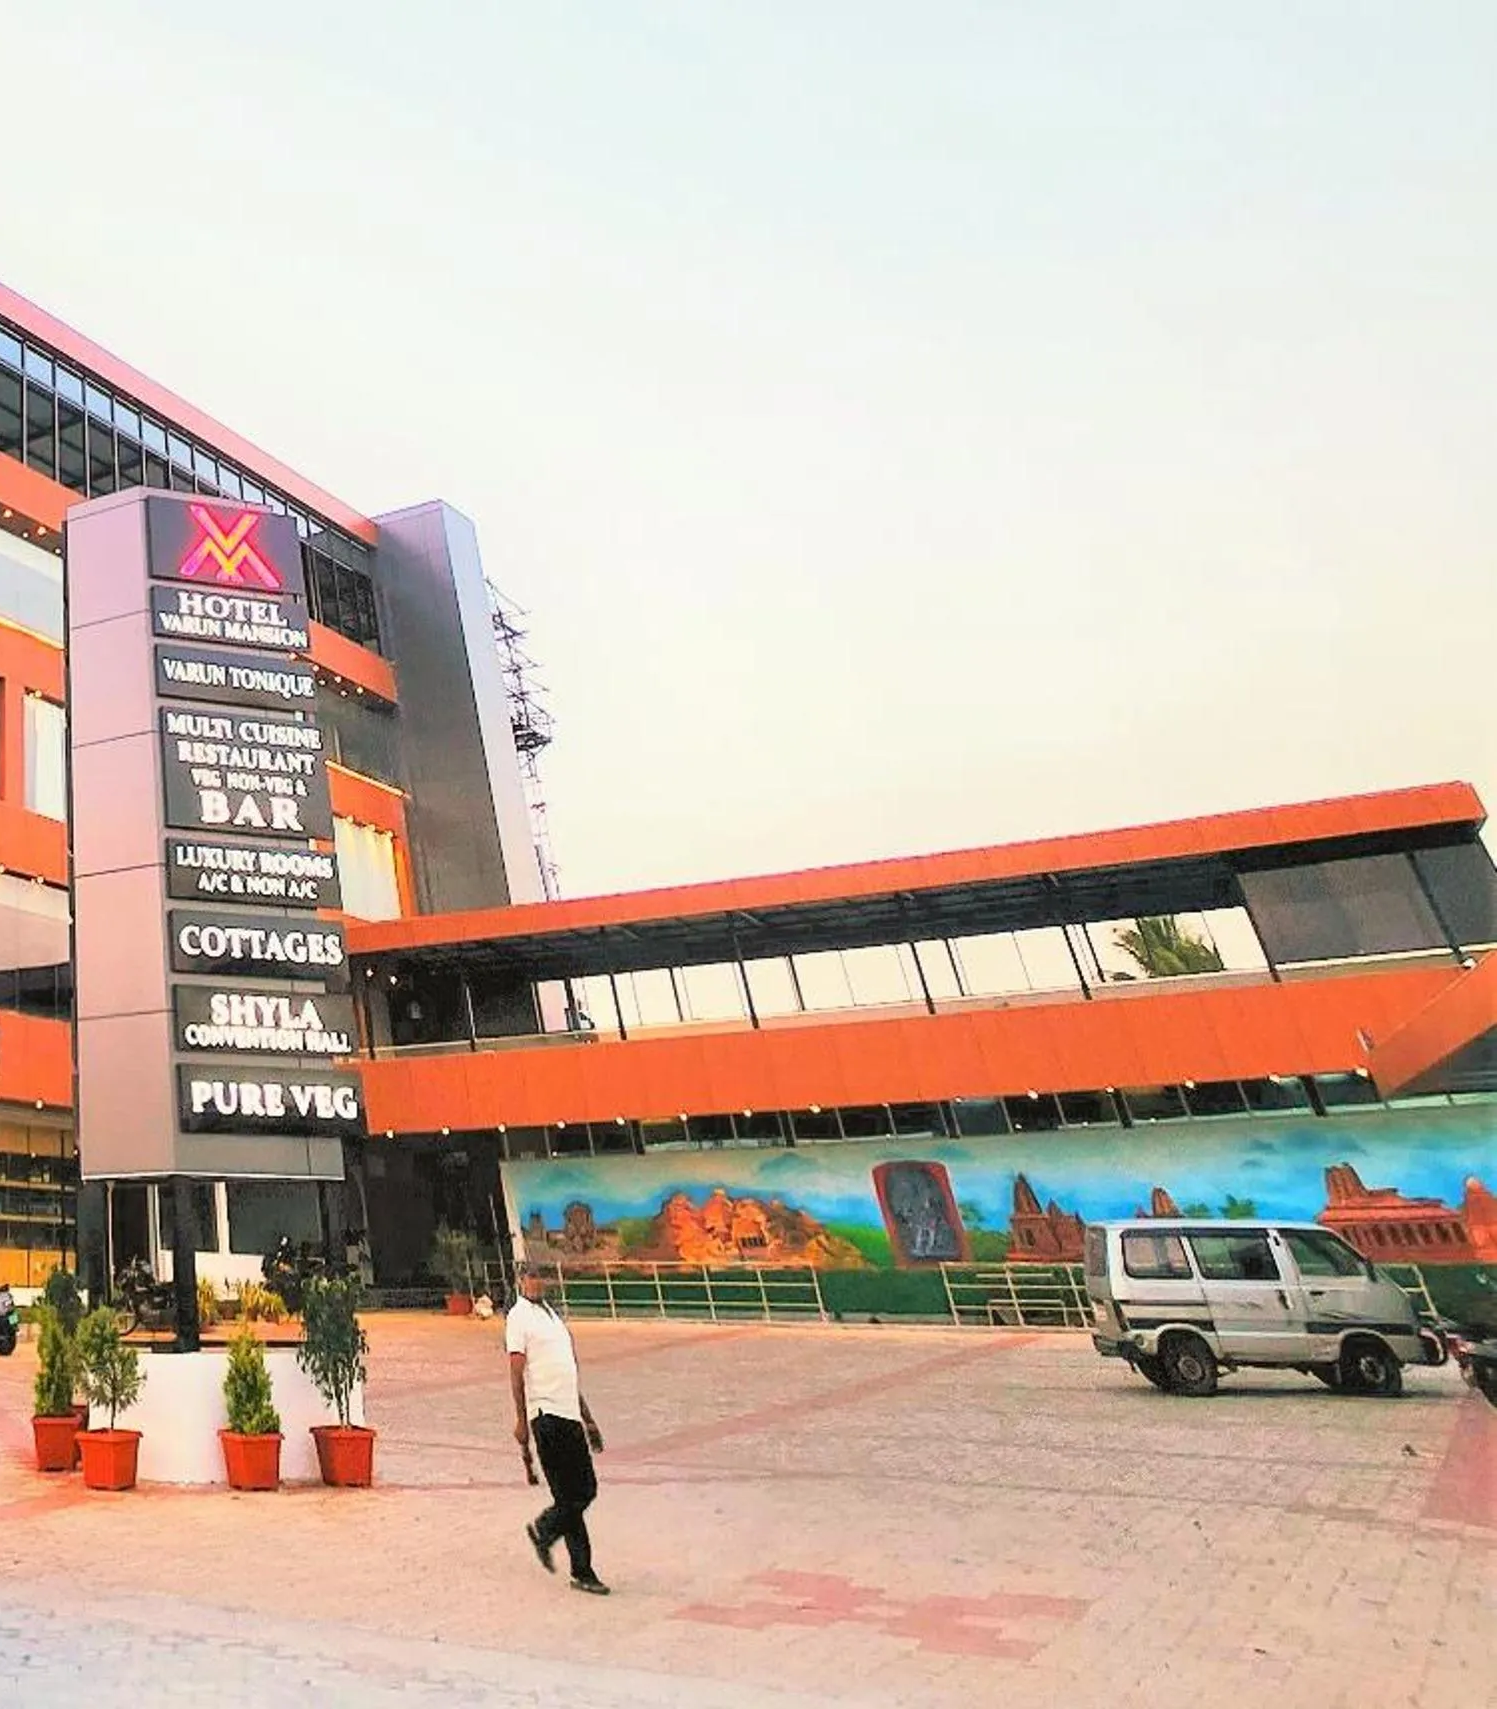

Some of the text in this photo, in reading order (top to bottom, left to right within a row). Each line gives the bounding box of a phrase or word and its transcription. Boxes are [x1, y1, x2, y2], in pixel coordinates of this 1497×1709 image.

[177, 591, 287, 627] HOTEL
[158, 611, 308, 648] VARUN MANSION
[162, 657, 315, 699] VARUN TONIQUE
[166, 712, 322, 750] MULTI CUISINE
[177, 740, 316, 775] RESTAURANT
[190, 767, 308, 797] VEG NON-VEG &
[198, 789, 304, 832] BAR
[175, 845, 334, 880] LUXURY ROOMS
[198, 871, 318, 900] A/C & NON A/C
[179, 924, 344, 966] COTTAGES
[210, 993, 325, 1031] SHYLA
[184, 1023, 352, 1053] CONVENTION HALL
[190, 1080, 358, 1119] PURE VEG
